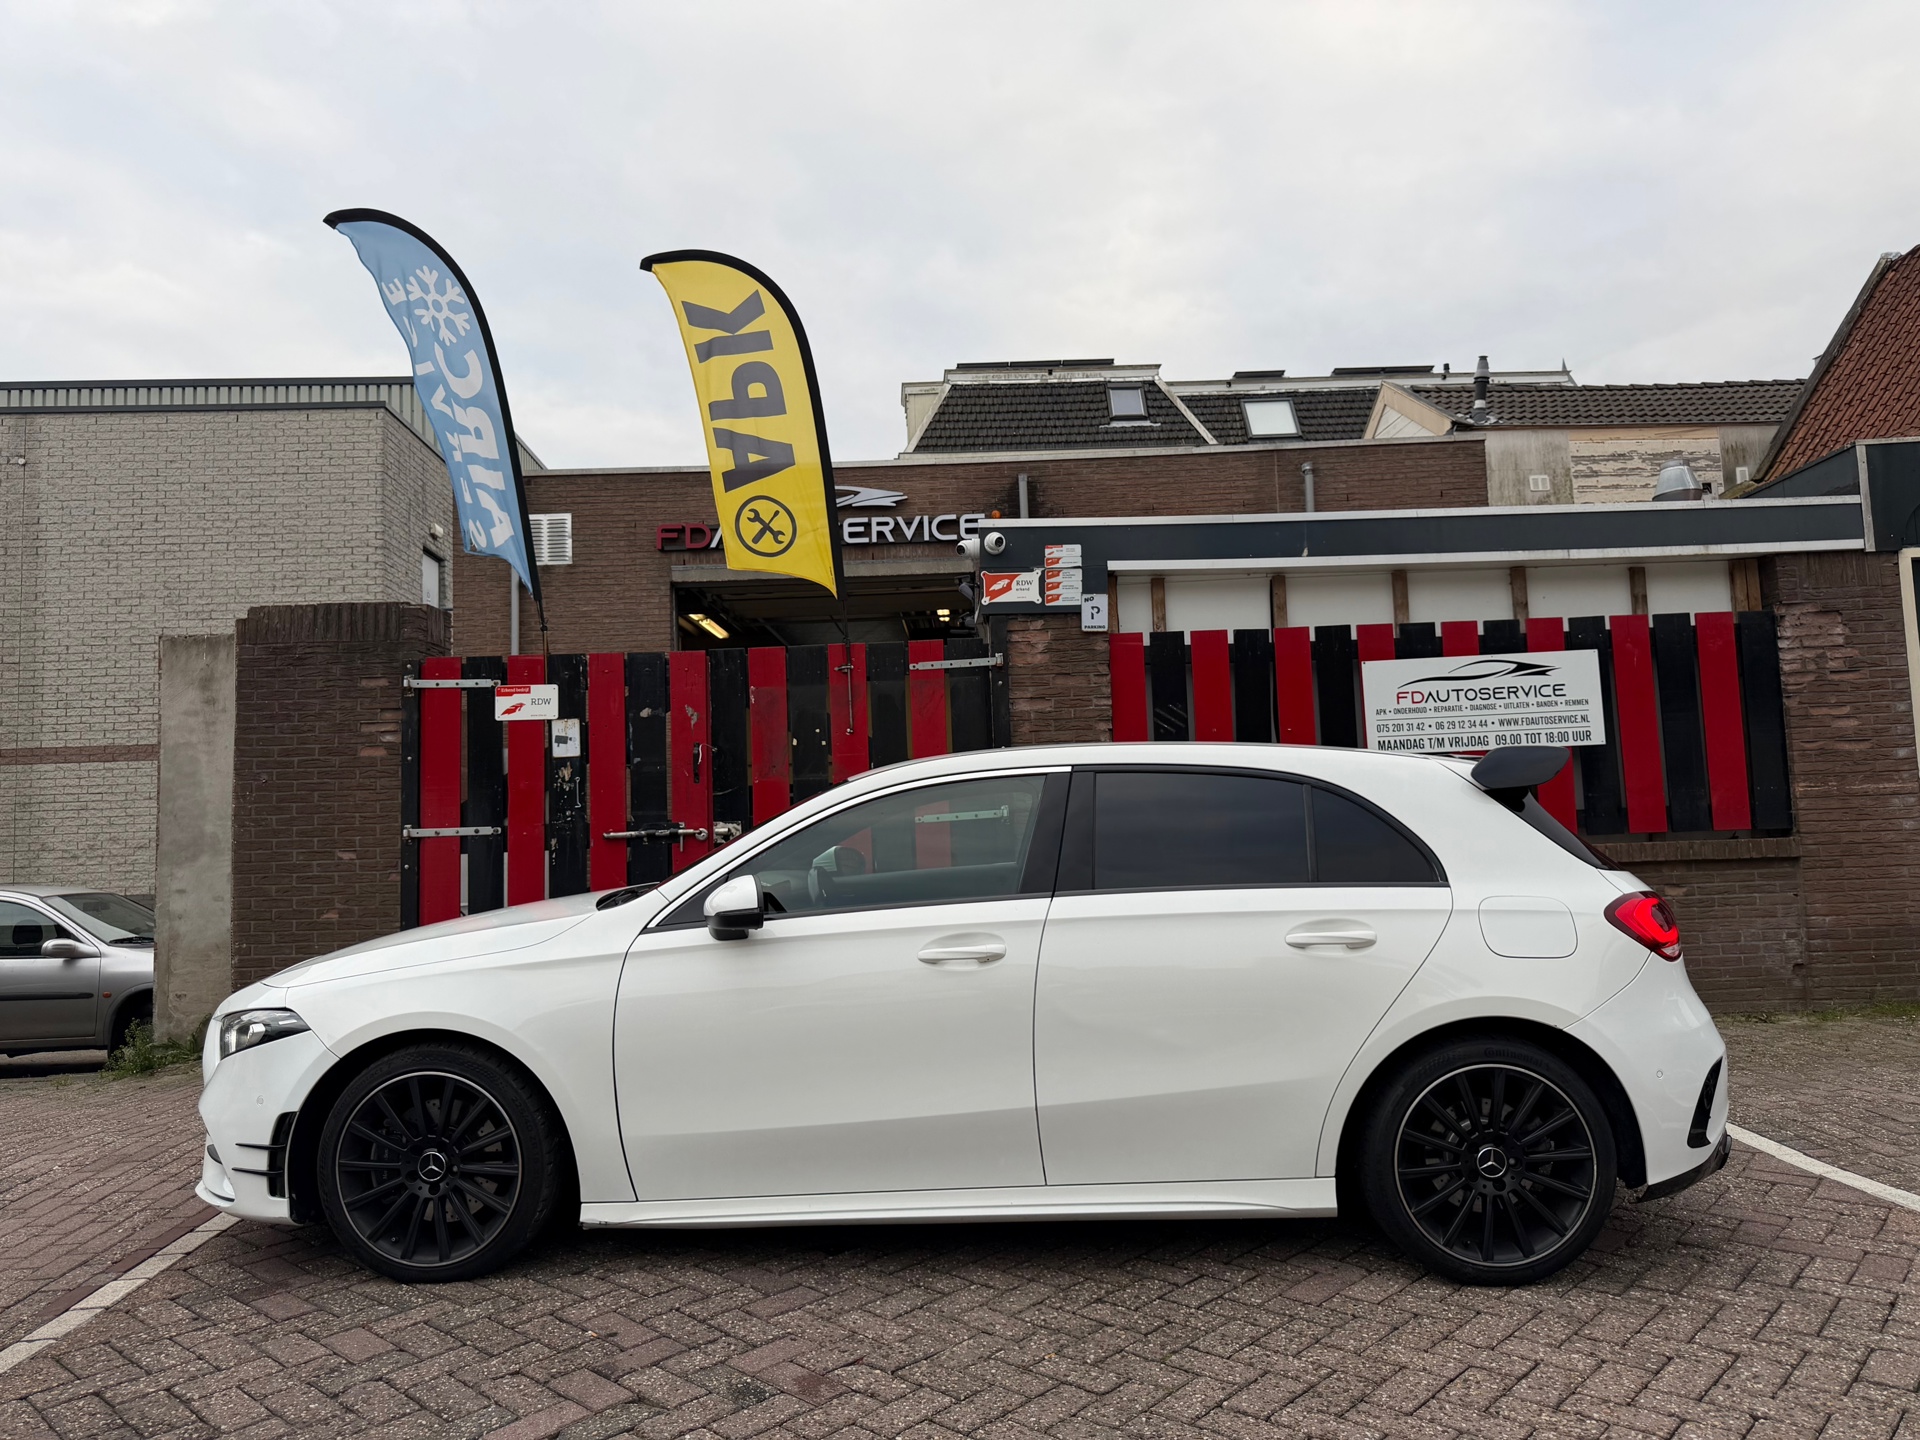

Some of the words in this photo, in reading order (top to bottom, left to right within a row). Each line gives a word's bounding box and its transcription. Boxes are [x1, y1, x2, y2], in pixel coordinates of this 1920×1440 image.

[1396, 684, 1566, 704] FDAUTOSERVICE
[1376, 708, 1387, 716] APK
[1393, 706, 1427, 715] ONDERHOUD
[1434, 705, 1463, 713] REPARATIE
[1470, 703, 1497, 711] DIAGNOSE
[1504, 702, 1530, 710] UITLATEN
[1536, 700, 1558, 708] BANDEN
[1376, 724, 1390, 733] 075
[1392, 723, 1404, 732] 201
[1406, 723, 1414, 732] 31
[1416, 722, 1425, 731] 42
[1435, 721, 1445, 730] 06
[1447, 720, 1456, 730] 29
[1458, 720, 1466, 729] 12
[1468, 720, 1477, 728] 34
[1479, 719, 1488, 728] 44
[1498, 714, 1590, 727] WWW.FDAUTOSERVICE.NL
[1378, 738, 1425, 751] MAANDAG
[1427, 736, 1445, 749] T/M
[1448, 735, 1489, 748] VRIJDAG
[1495, 733, 1522, 746] 09.00
[1524, 732, 1542, 744] TOT
[1545, 731, 1569, 743] 18:00
[1572, 730, 1592, 742] UUR
[1484, 1046, 1543, 1068] Continental
